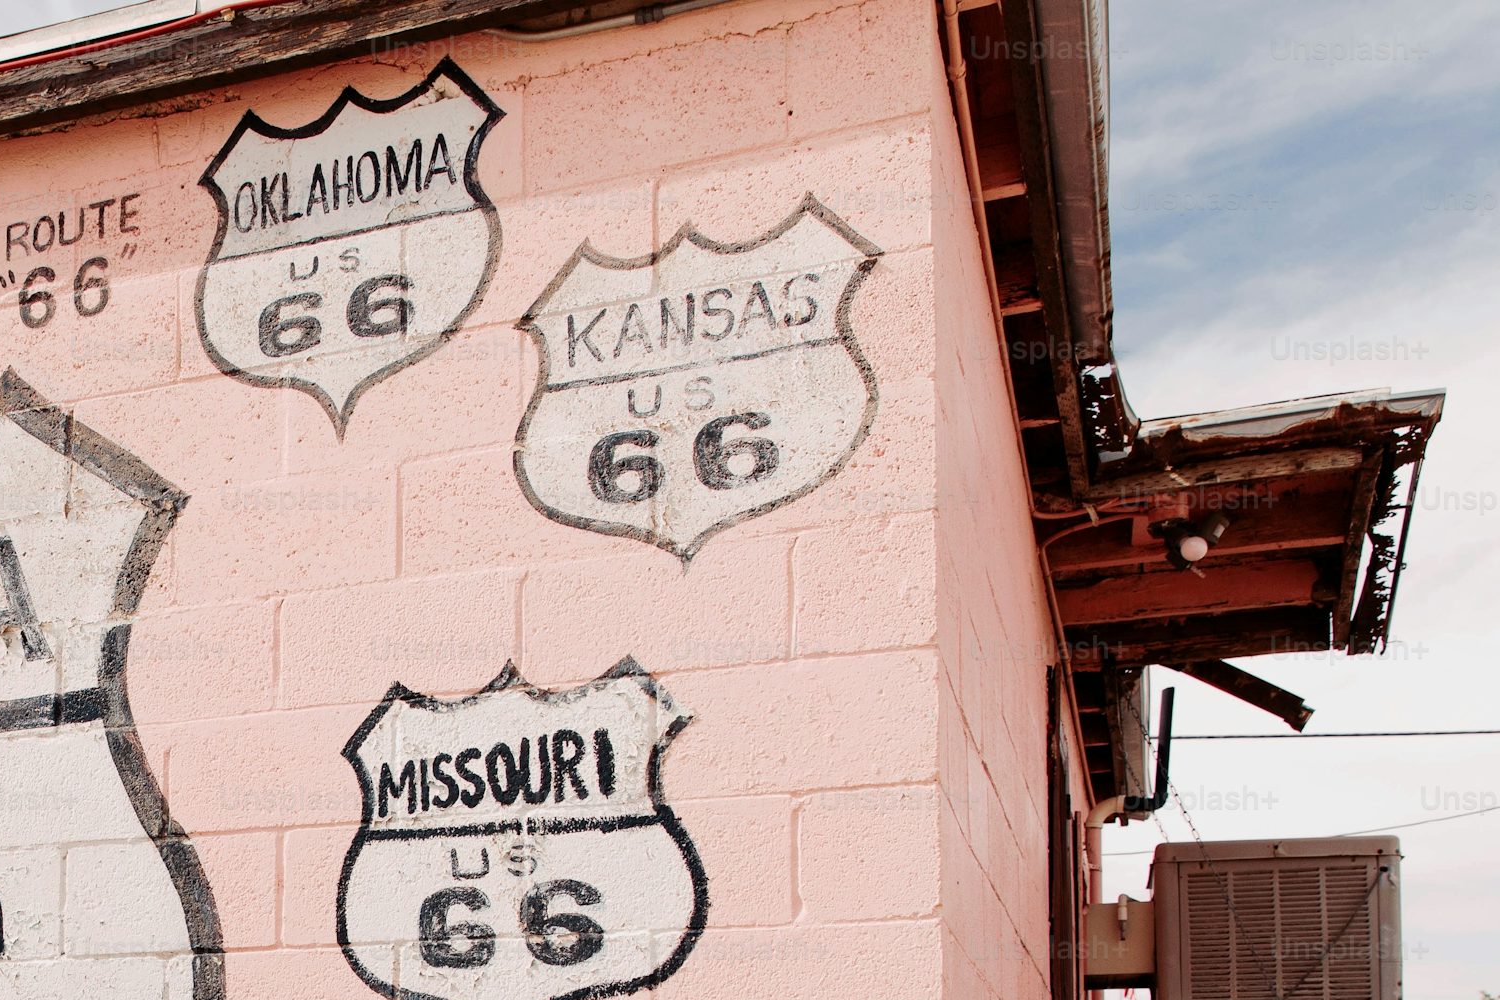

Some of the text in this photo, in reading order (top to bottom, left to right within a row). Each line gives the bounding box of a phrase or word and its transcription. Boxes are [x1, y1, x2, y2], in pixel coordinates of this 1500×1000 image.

[6, 193, 141, 261] ROUTE
[234, 133, 457, 233] OKLAHOMA
[258, 274, 415, 357] 66
[566, 273, 820, 367] KANSAS
[587, 412, 780, 503] 66
[378, 728, 616, 818] MISSOURI
[419, 878, 604, 968] 66
